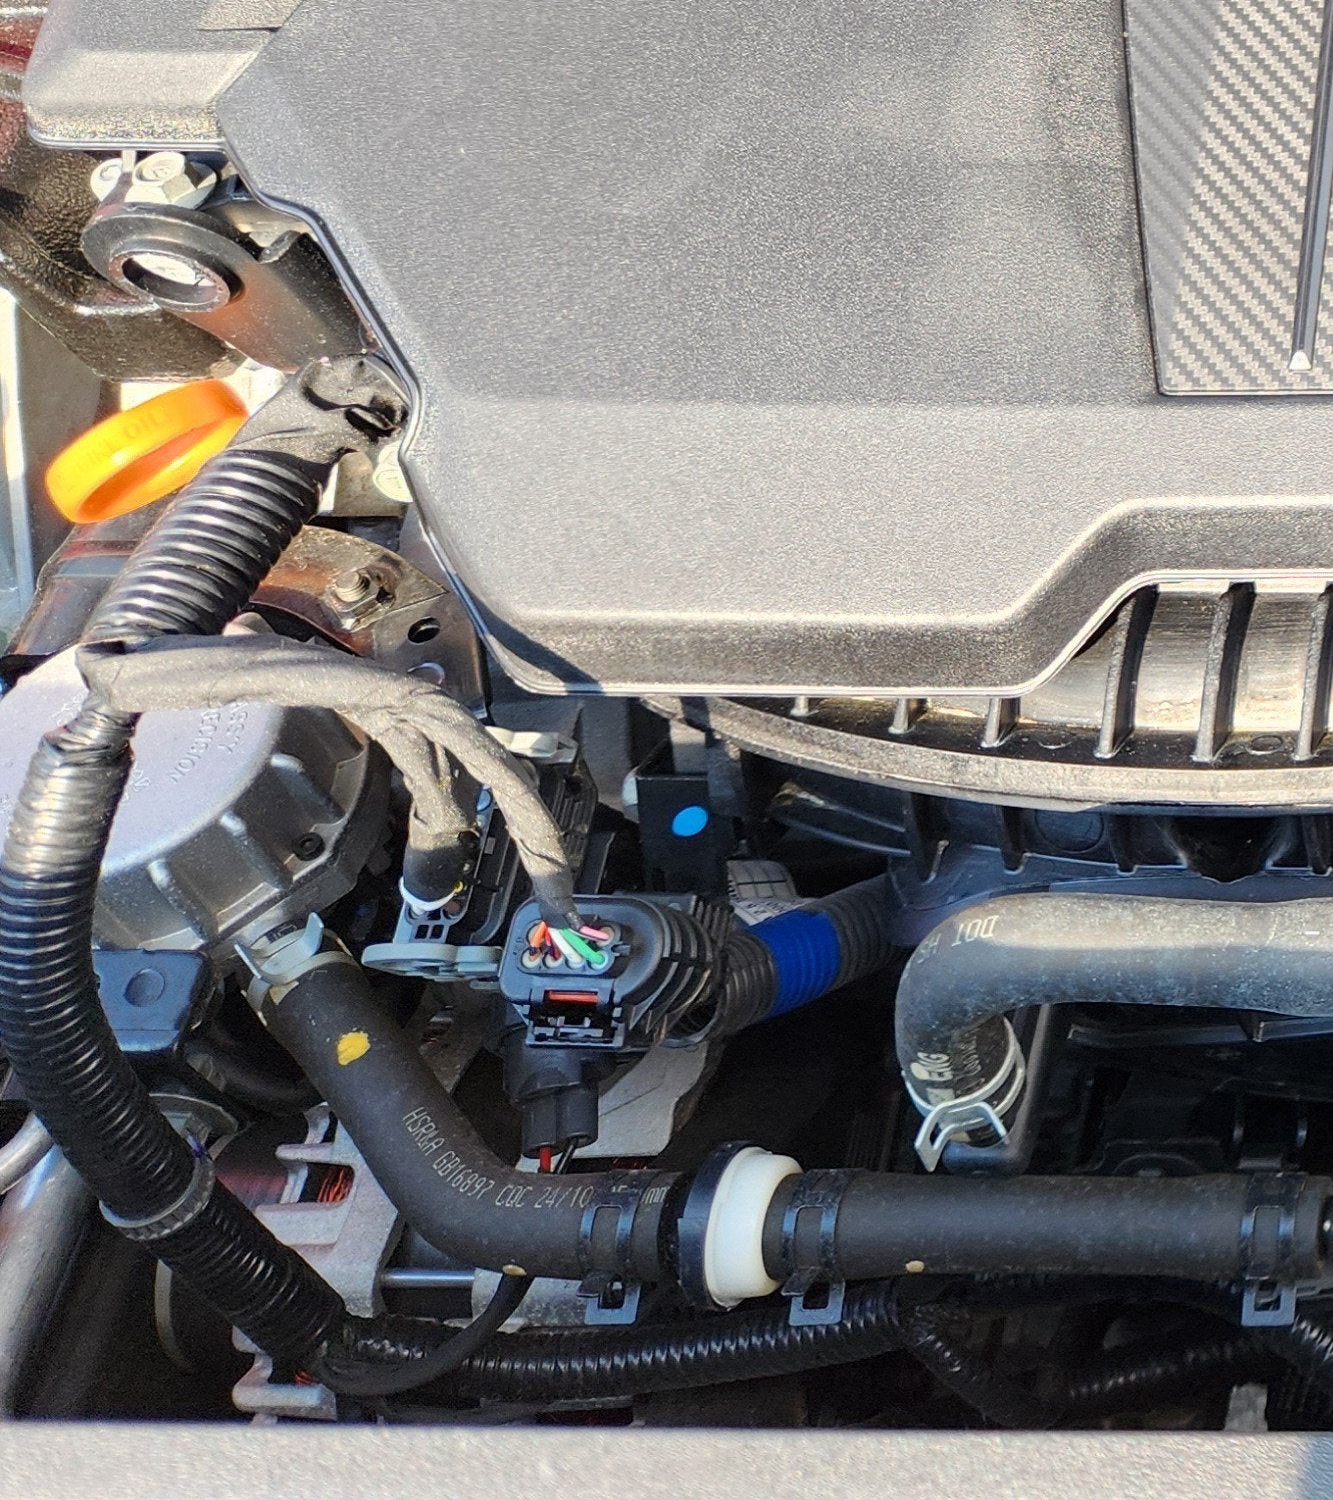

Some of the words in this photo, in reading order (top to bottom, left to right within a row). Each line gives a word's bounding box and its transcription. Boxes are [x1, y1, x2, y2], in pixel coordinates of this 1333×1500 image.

[951, 915, 1000, 947] DOT
[431, 1149, 495, 1201] GB16897
[494, 1184, 534, 1207] CQC
